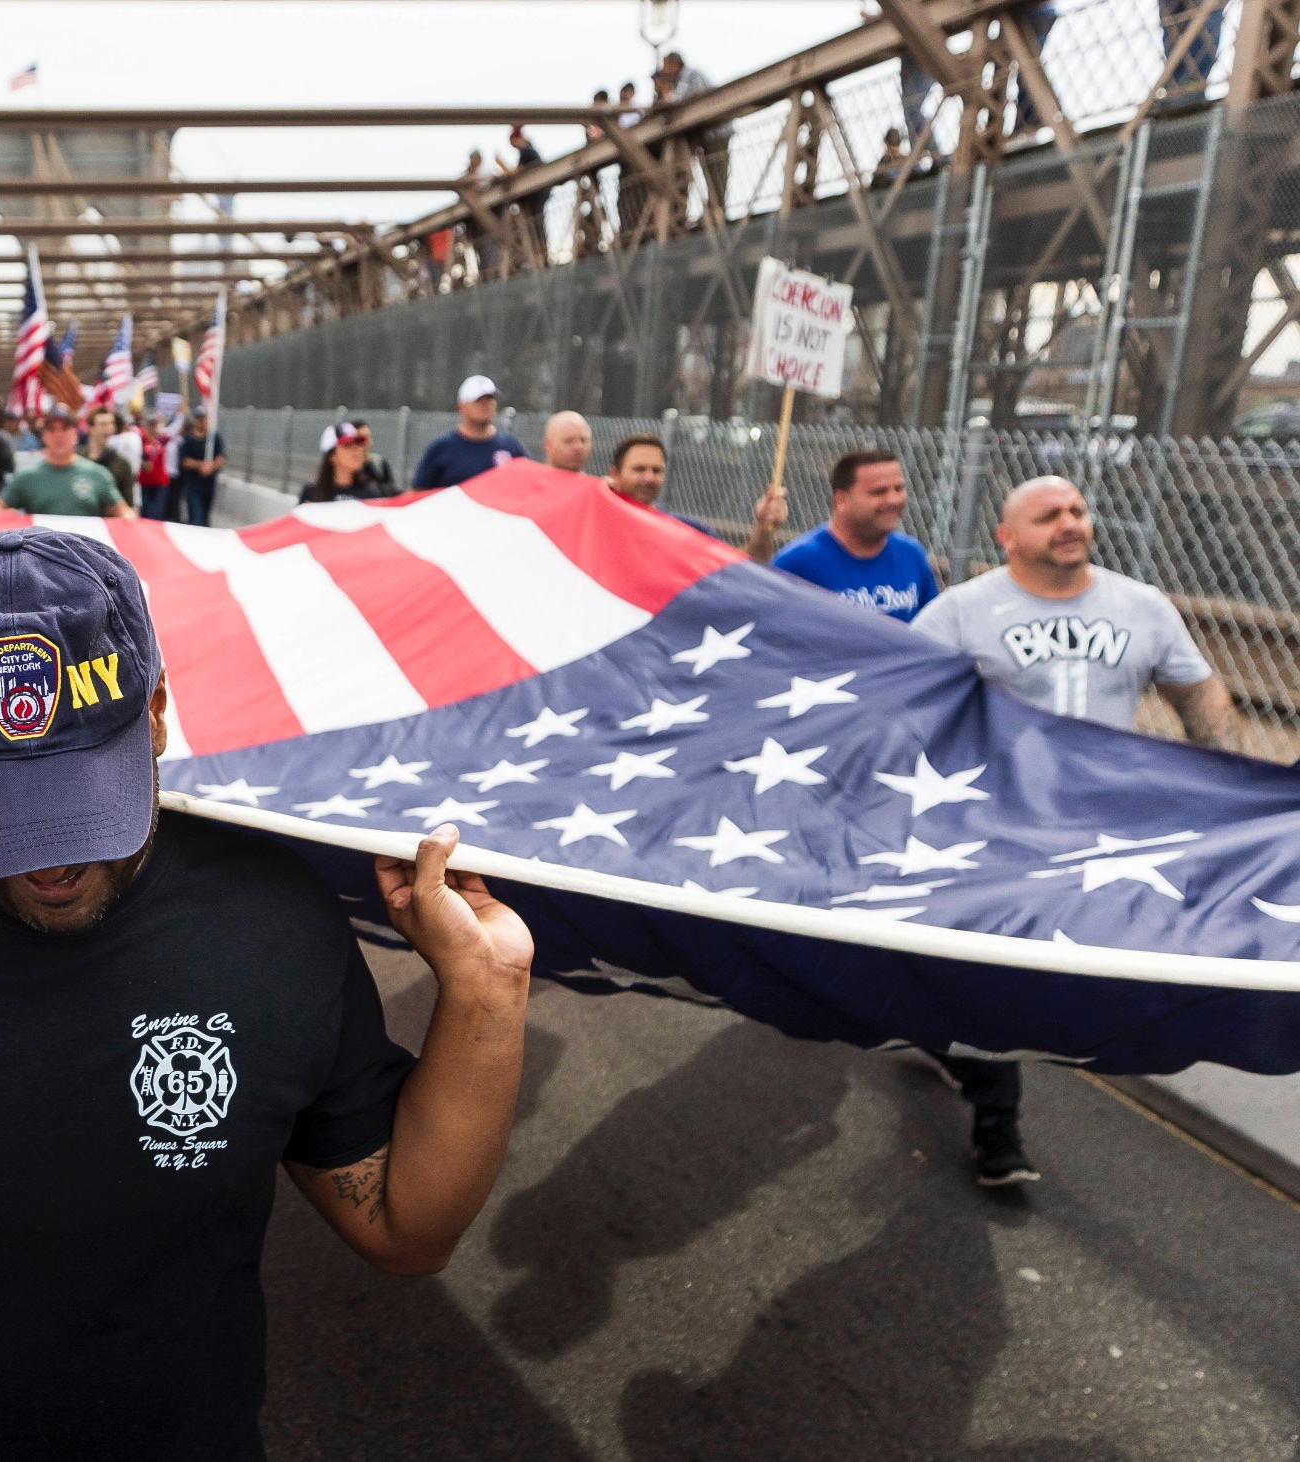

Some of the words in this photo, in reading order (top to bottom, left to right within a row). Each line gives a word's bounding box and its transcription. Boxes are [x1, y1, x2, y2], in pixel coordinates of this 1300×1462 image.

[772, 272, 845, 323] COERCION
[774, 311, 793, 342] IS
[797, 322, 832, 352] NOT
[767, 347, 824, 387] CHOICE
[1002, 615, 1132, 670] BKLYN
[0, 654, 20, 664] CITY
[21, 652, 35, 661] OF
[17, 661, 41, 672] YORK
[66, 652, 125, 710] NY
[131, 1012, 200, 1039] Engine
[206, 1012, 237, 1034] Co.
[170, 1037, 202, 1050] F.D.
[167, 1070, 204, 1094] 65
[170, 1114, 201, 1127] N.Y.
[138, 1135, 179, 1151] Times
[182, 1135, 228, 1155] Square
[153, 1153, 209, 1171] N.Y.C.
